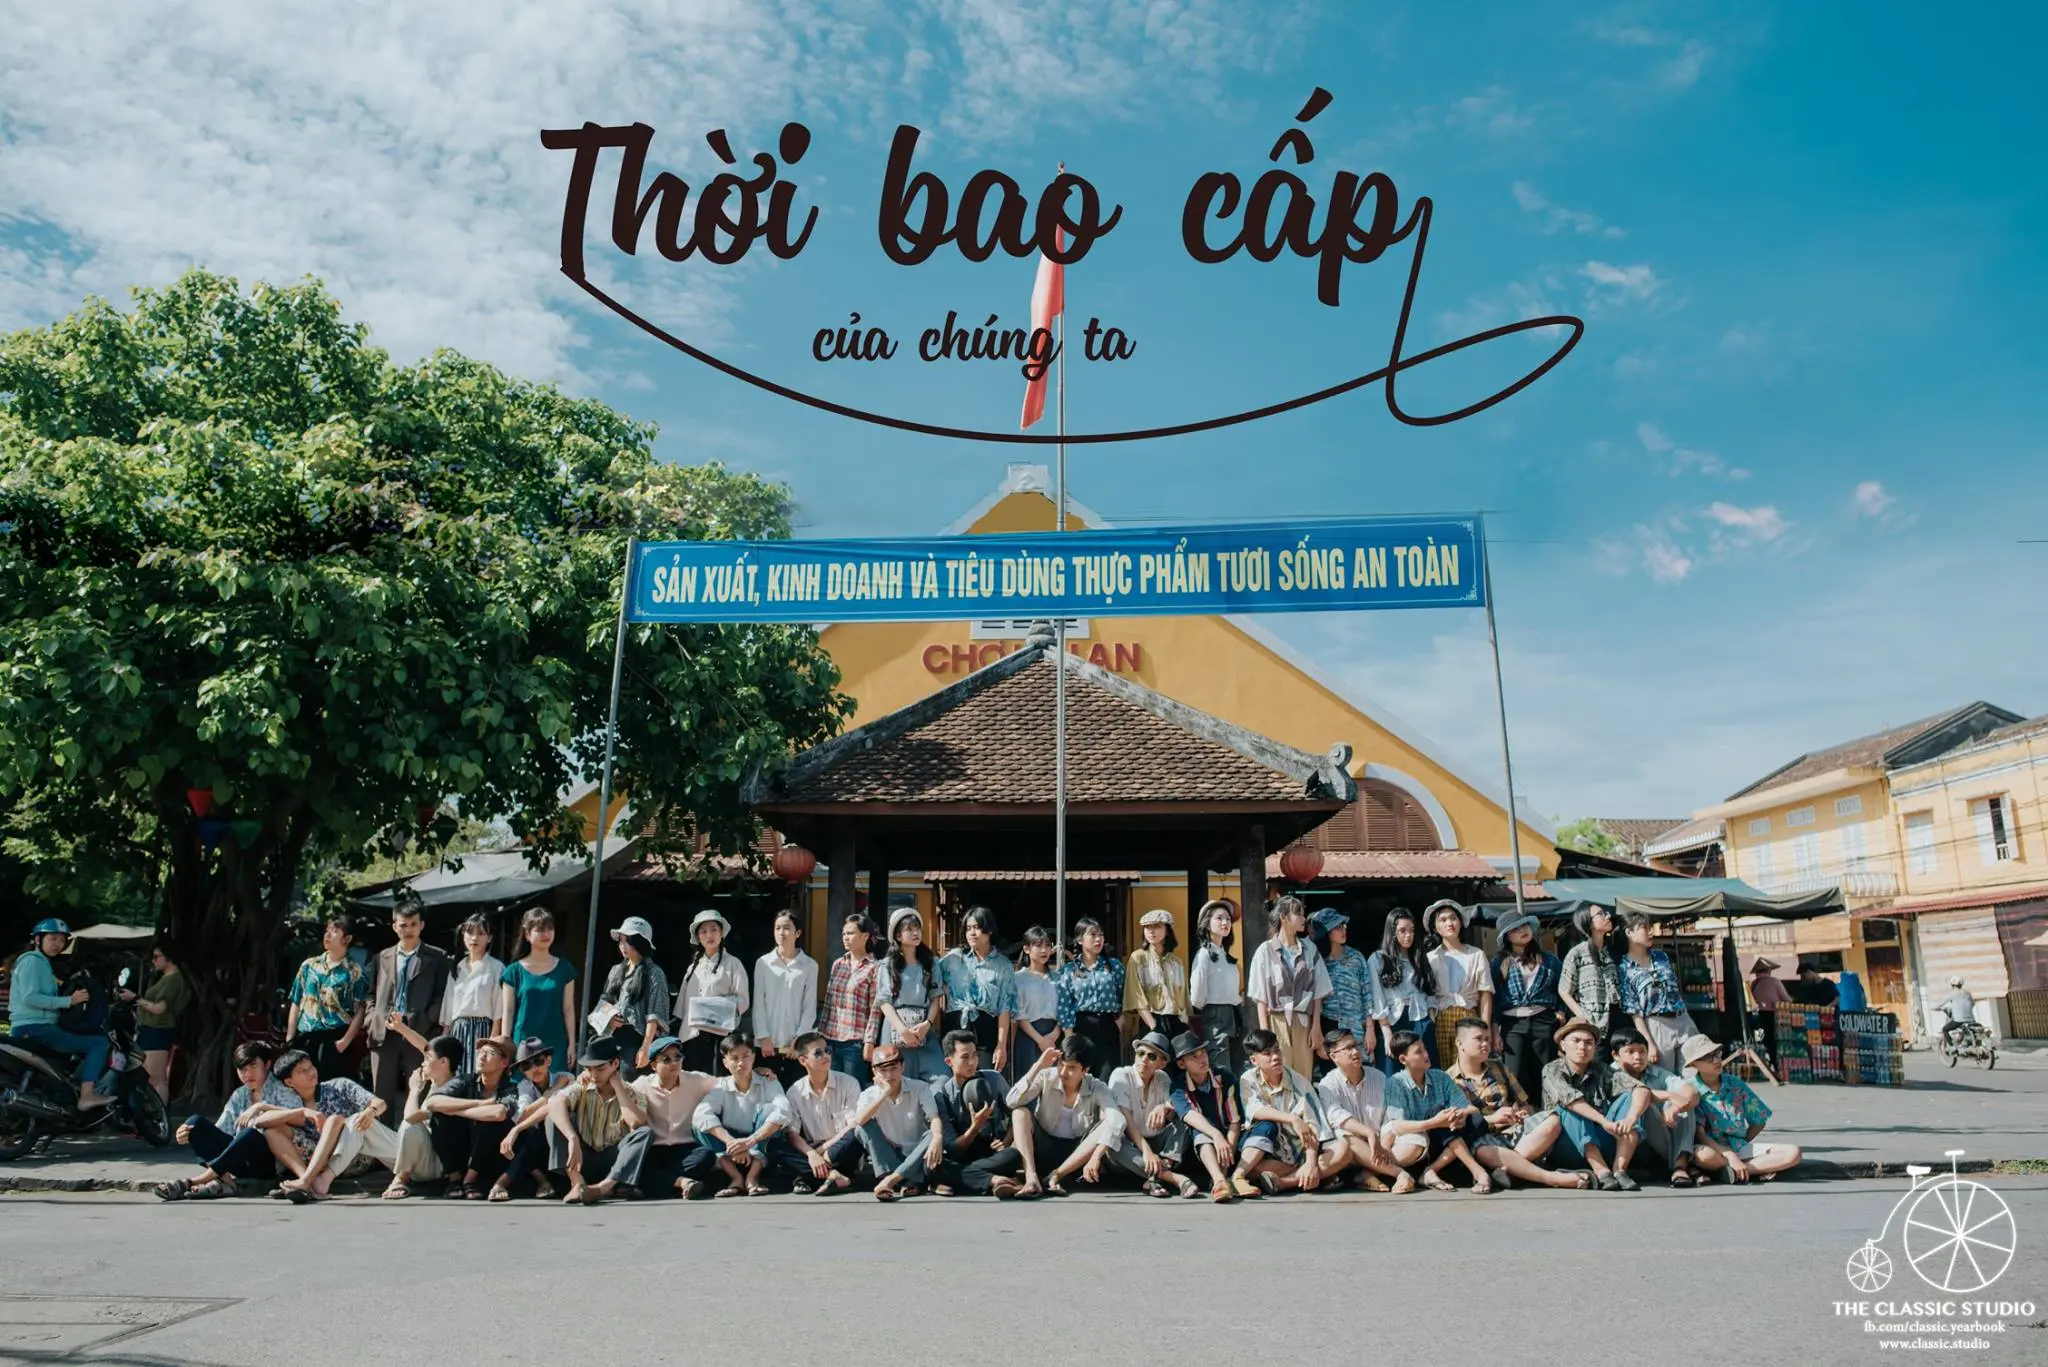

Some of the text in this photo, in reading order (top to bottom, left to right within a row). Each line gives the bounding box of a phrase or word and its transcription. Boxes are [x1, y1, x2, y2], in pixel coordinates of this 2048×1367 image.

[652, 535, 1460, 606] SẢN XUẤT, KINH DOANH VÀ TIÊU DÙNG THỰC PHẨM TƯƠI SỐNG AN TOÀN
[1087, 643, 1141, 672] AN
